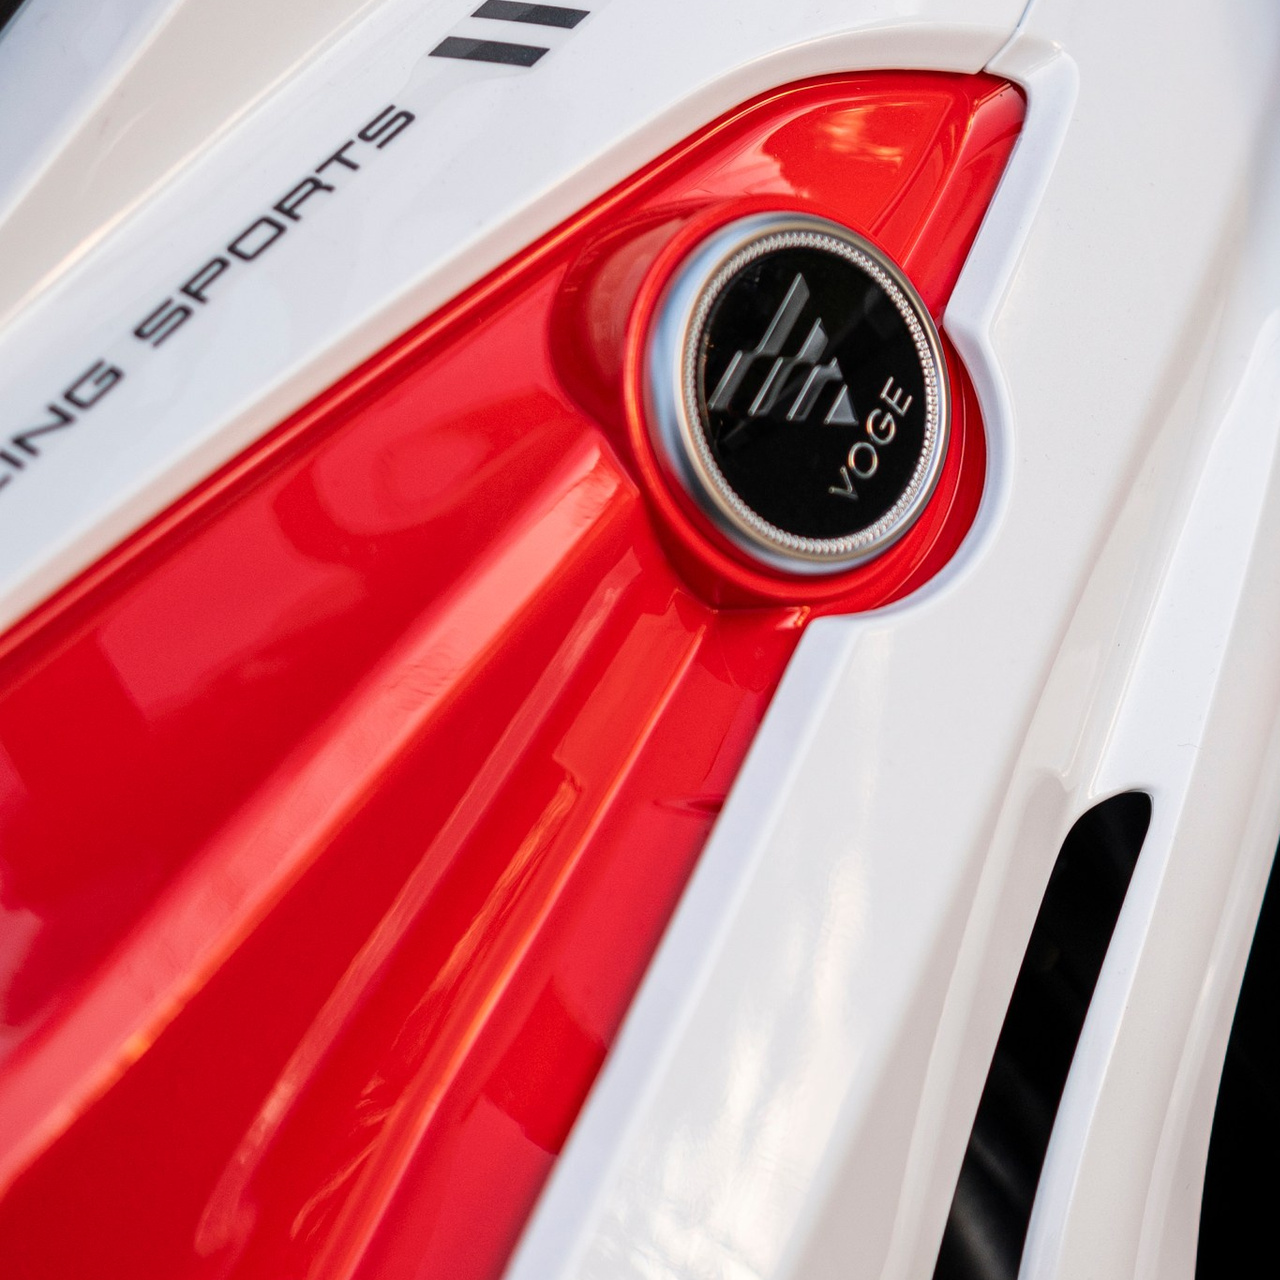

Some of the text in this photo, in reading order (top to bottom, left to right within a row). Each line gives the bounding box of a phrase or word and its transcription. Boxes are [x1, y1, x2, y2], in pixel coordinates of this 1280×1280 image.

[0, 104, 416, 490] ING SPORTS
[828, 375, 913, 501] VOGE
